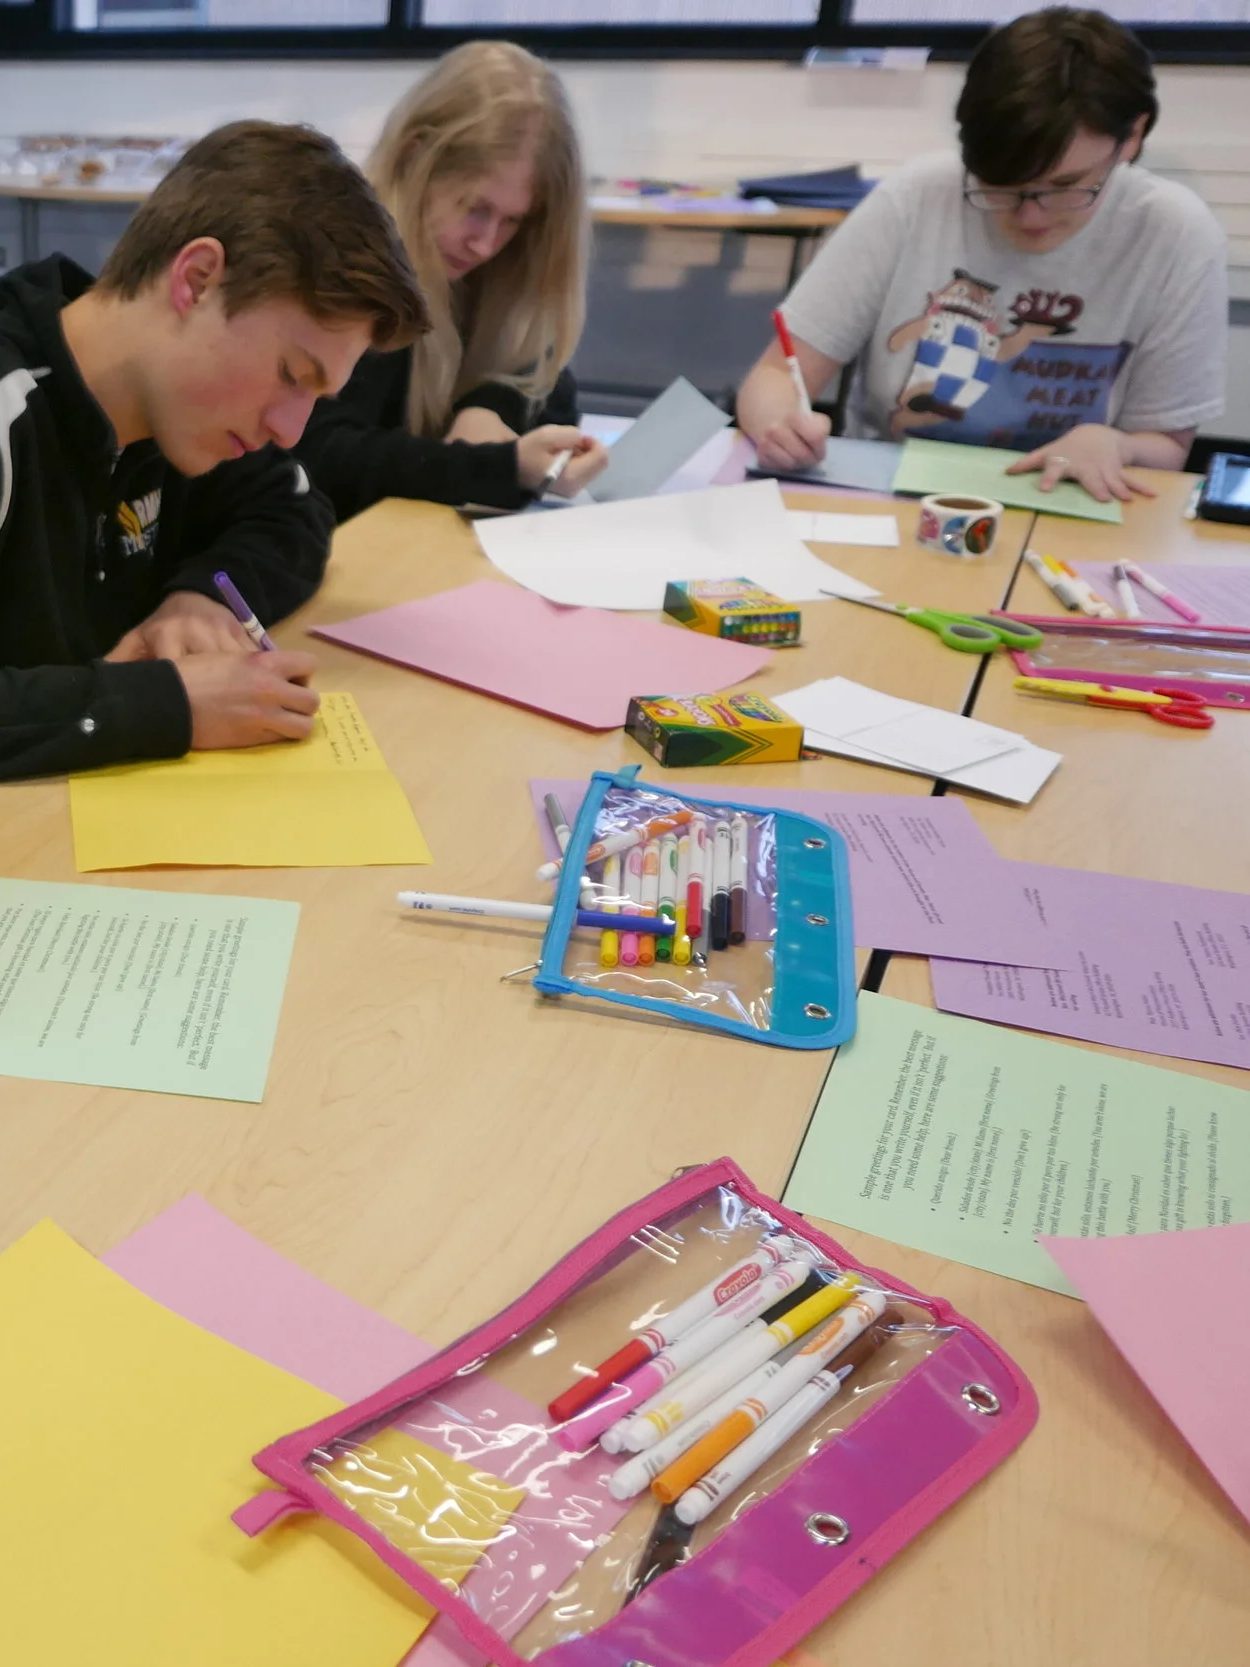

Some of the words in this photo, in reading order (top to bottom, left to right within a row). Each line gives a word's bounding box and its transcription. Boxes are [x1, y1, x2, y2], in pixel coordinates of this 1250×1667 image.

[208, 929, 217, 939] you
[221, 933, 230, 943] that
[205, 939, 214, 952] need
[217, 943, 226, 953] you
[229, 934, 241, 957] greetings
[201, 951, 210, 965] some
[214, 953, 223, 967] write
[228, 957, 238, 966] for
[224, 965, 234, 978] your
[193, 978, 204, 990] here
[191, 990, 199, 1000] are
[204, 989, 213, 1002] even
[186, 1000, 196, 1014] some
[214, 992, 228, 1020] Remember,
[177, 1015, 191, 1047] suggestions:
[210, 1022, 221, 1031] the
[207, 1031, 217, 1045] best
[909, 1030, 923, 1051] message
[923, 1040, 935, 1051] But
[188, 1049, 199, 1060] But
[199, 1045, 212, 1069] message
[902, 1051, 914, 1064] best
[899, 1063, 911, 1073] the
[990, 1066, 1001, 1077] from
[889, 1075, 906, 1104] Remember,
[928, 1086, 939, 1102] some
[986, 1077, 999, 1099] (Greetings
[908, 1096, 918, 1110] even
[1056, 1091, 1066, 1102] only
[925, 1102, 934, 1113] are
[1055, 1101, 1063, 1110] not
[900, 1111, 914, 1136] yourself,
[918, 1112, 932, 1127] here
[1052, 1110, 1063, 1125] strong
[882, 1119, 893, 1135] your
[975, 1127, 986, 1141] llamo
[1049, 1125, 1060, 1134] (Be
[876, 1134, 888, 1145] for
[894, 1136, 906, 1154] write
[912, 1142, 923, 1159] some
[1047, 1147, 1056, 1156] tus
[1177, 1140, 1188, 1158] fighting
[870, 1145, 886, 1174] greetings
[890, 1154, 902, 1167] you
[1046, 1155, 1054, 1166] por
[1090, 1157, 1099, 1168] por
[1179, 1158, 1187, 1171] your
[884, 1166, 897, 1180] that
[907, 1159, 918, 1176] need
[984, 1163, 993, 1178] name
[1044, 1165, 1053, 1178] pero
[903, 1176, 914, 1190] you
[930, 1183, 943, 1204] Querido
[940, 1151, 951, 1165] (Dear
[980, 1177, 991, 1186] My
[1002, 1217, 1012, 1226] No
[1009, 1188, 1019, 1199] por
[1019, 1140, 1028, 1152] give
[1086, 1167, 1096, 1190] luchando
[1162, 1174, 1170, 1188] saber
[1176, 1170, 1185, 1184] what
[859, 1174, 876, 1198] Sample
[882, 1180, 893, 1194] one
[964, 1177, 975, 1192] desde
[1041, 1182, 1050, 1193] por
[878, 1193, 890, 1201] is
[1055, 1185, 1065, 1199] your
[1100, 1192, 1108, 1205] with
[1176, 1184, 1186, 1207] knowing
[959, 1192, 971, 1212] Saludos
[1038, 1203, 1046, 1211] no
[1052, 1197, 1062, 1207] for
[1084, 1191, 1093, 1212] estamos
[1159, 1195, 1169, 1217] Navidad
[1050, 1206, 1061, 1216] but
[1097, 1205, 1107, 1221] battle
[1127, 1205, 1138, 1224] (Merry
[1174, 1212, 1185, 1223] gift
[1033, 1211, 1045, 1228] fuerte
[1095, 1221, 1105, 1232] this
[1160, 1217, 1169, 1231] para
[716, 1265, 760, 1303] Crayola
